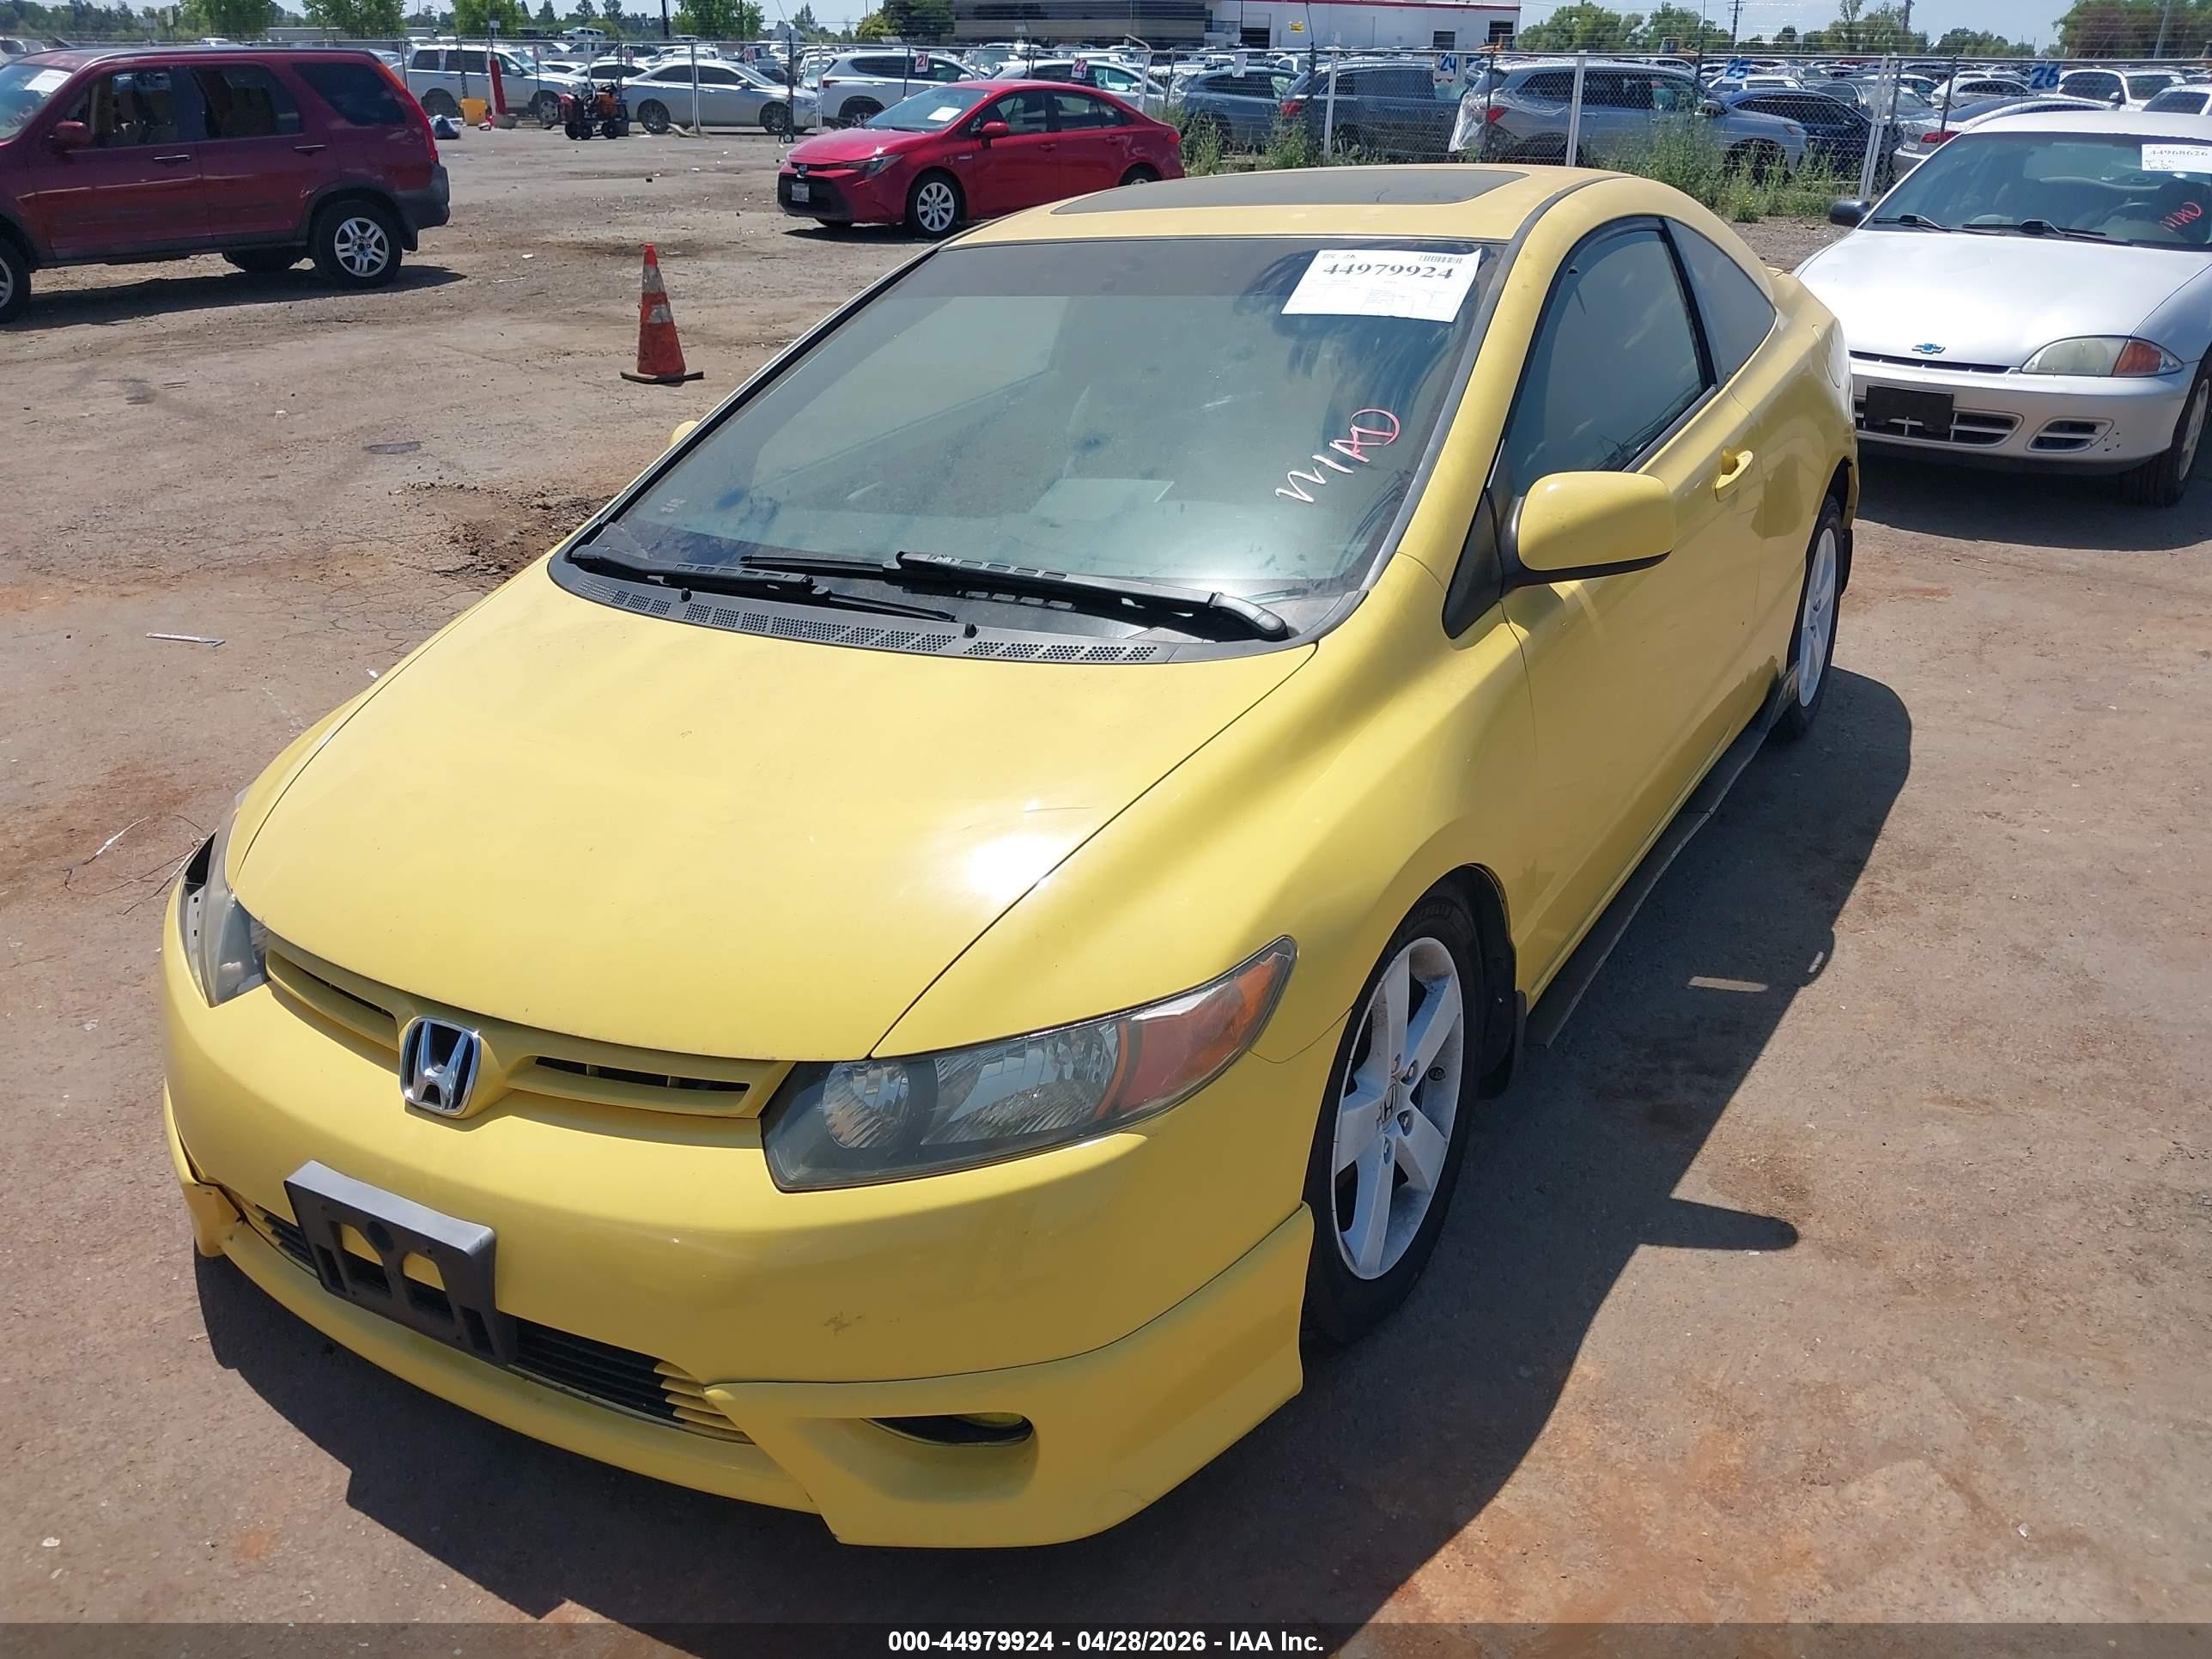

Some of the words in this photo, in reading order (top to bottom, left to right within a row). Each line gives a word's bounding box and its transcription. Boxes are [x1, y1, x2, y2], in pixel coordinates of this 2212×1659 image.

[916, 53, 928, 68] 21
[1073, 58, 1087, 75] 22
[1439, 53, 1457, 76] 24
[1725, 58, 1753, 80] 25
[2030, 65, 2060, 90] 26
[1323, 263, 1454, 280] 44979924
